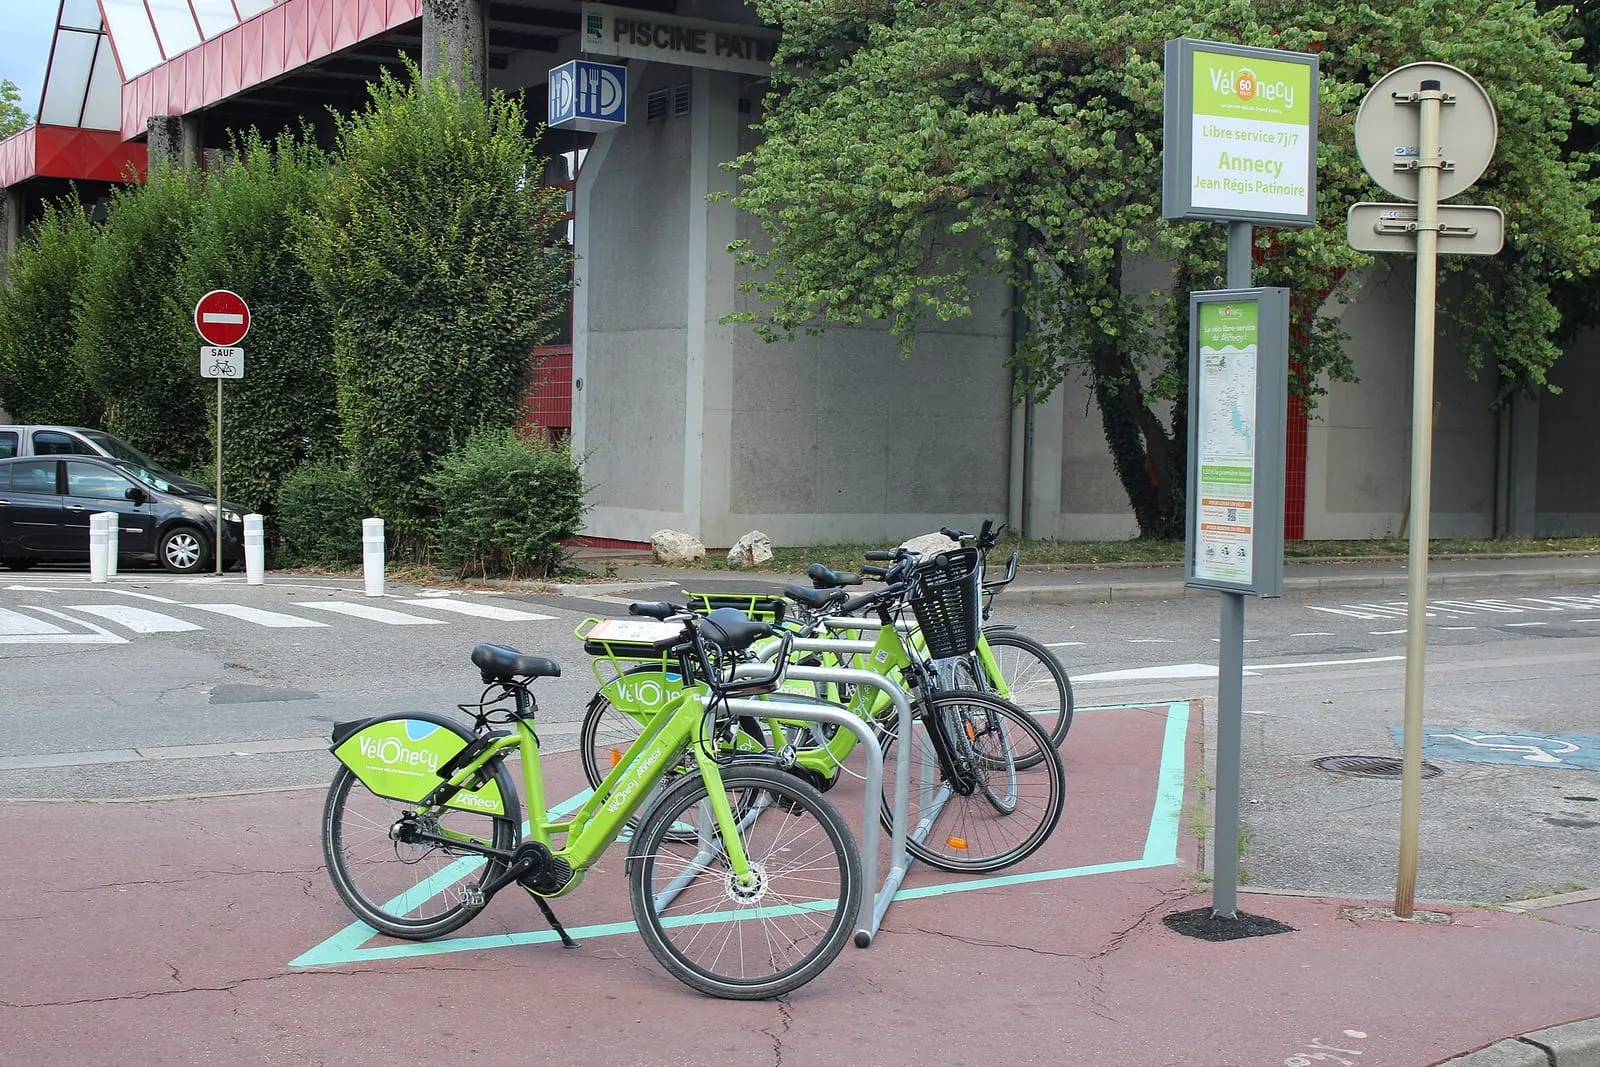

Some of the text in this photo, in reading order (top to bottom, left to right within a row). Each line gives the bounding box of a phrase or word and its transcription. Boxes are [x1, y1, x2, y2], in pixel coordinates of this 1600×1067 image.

[613, 18, 706, 55] PISCINE
[1239, 80, 1251, 91] 60
[1202, 124, 1299, 147] Libre service 7j/7
[1218, 151, 1284, 179] Annecy
[1194, 175, 1305, 197] Jean Régis Patinoire
[211, 348, 235, 357] SAUF
[359, 736, 439, 774] VélOnecy
[455, 793, 500, 810] Annecy
